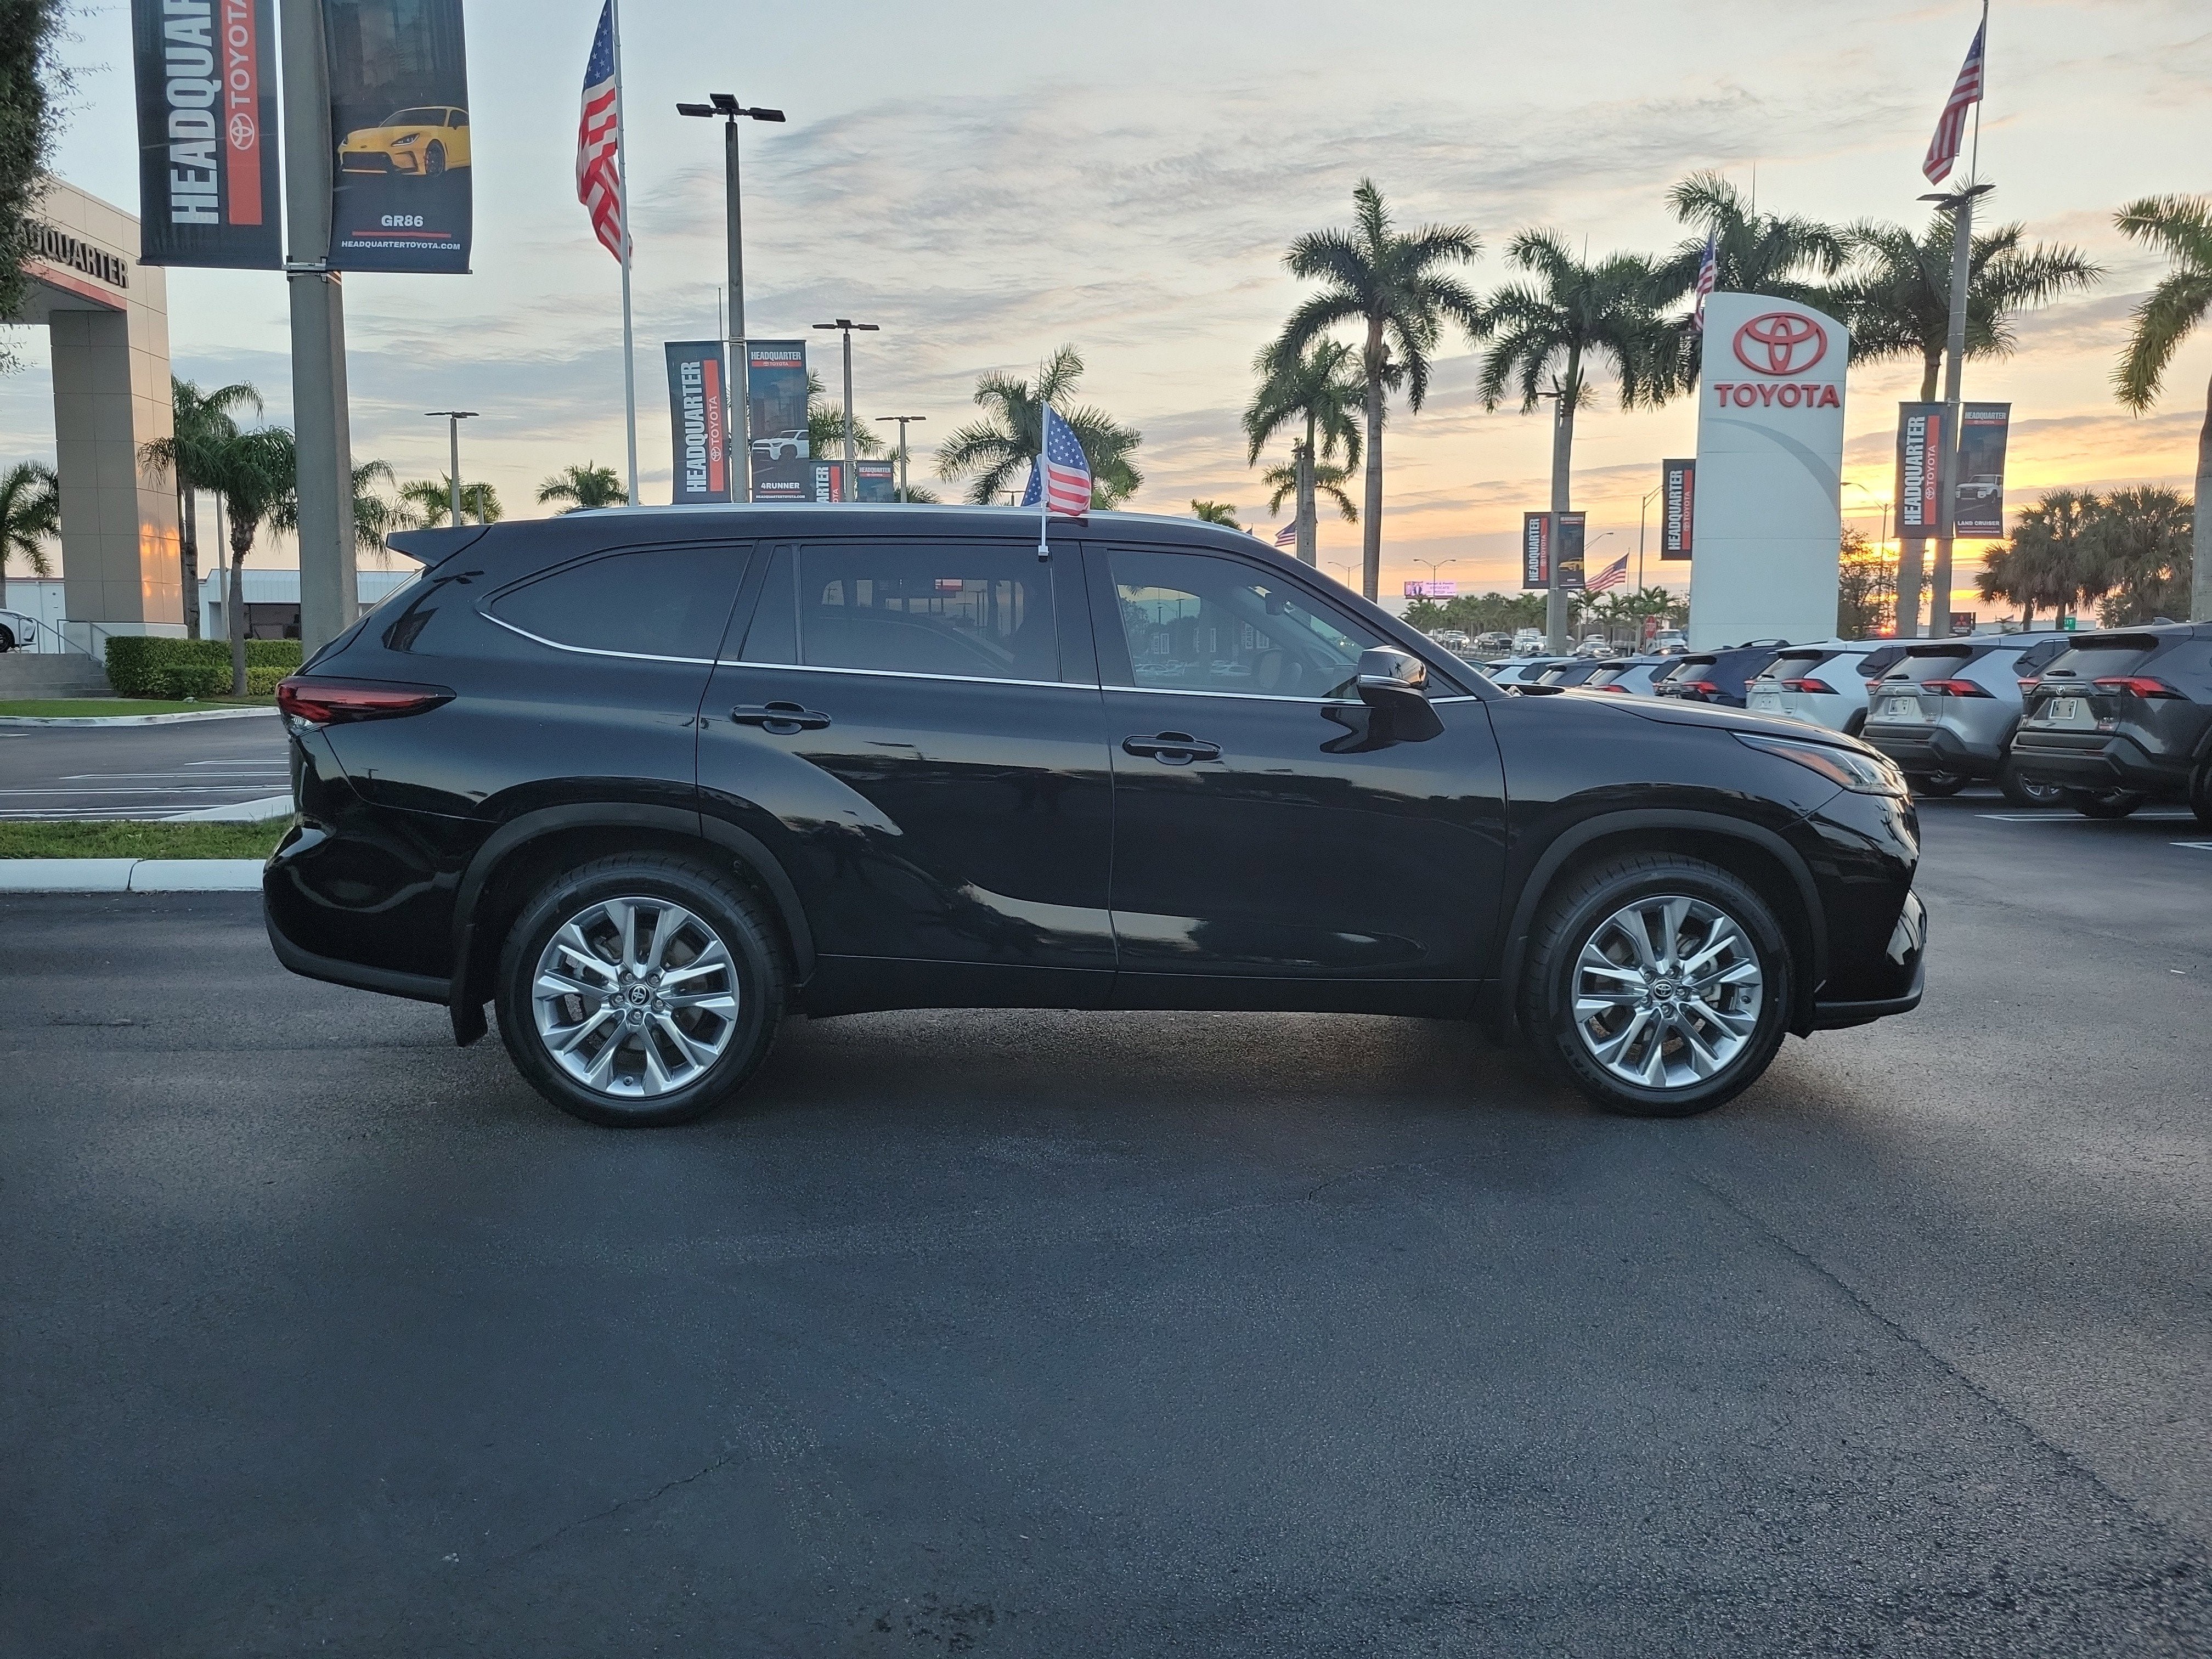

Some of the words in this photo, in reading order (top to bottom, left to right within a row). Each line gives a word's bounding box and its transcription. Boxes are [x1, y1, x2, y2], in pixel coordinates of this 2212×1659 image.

[381, 215, 424, 227] GR86
[341, 241, 460, 250] HEADQUARTERTOYOTA.COM
[751, 352, 802, 361] HEADQUARTER
[1714, 383, 1840, 408] TOYOTA
[1965, 411, 2006, 420] HEADQUARTER
[681, 361, 708, 492] HEADQUARTER
[708, 396, 719, 445] TOYOTA
[1904, 416, 1925, 525] HEADQUARTER
[1926, 445, 1936, 486] TOYOTA
[1668, 470, 1683, 550] HEADQUARTER
[1528, 518, 1540, 582] HEADQUARTER
